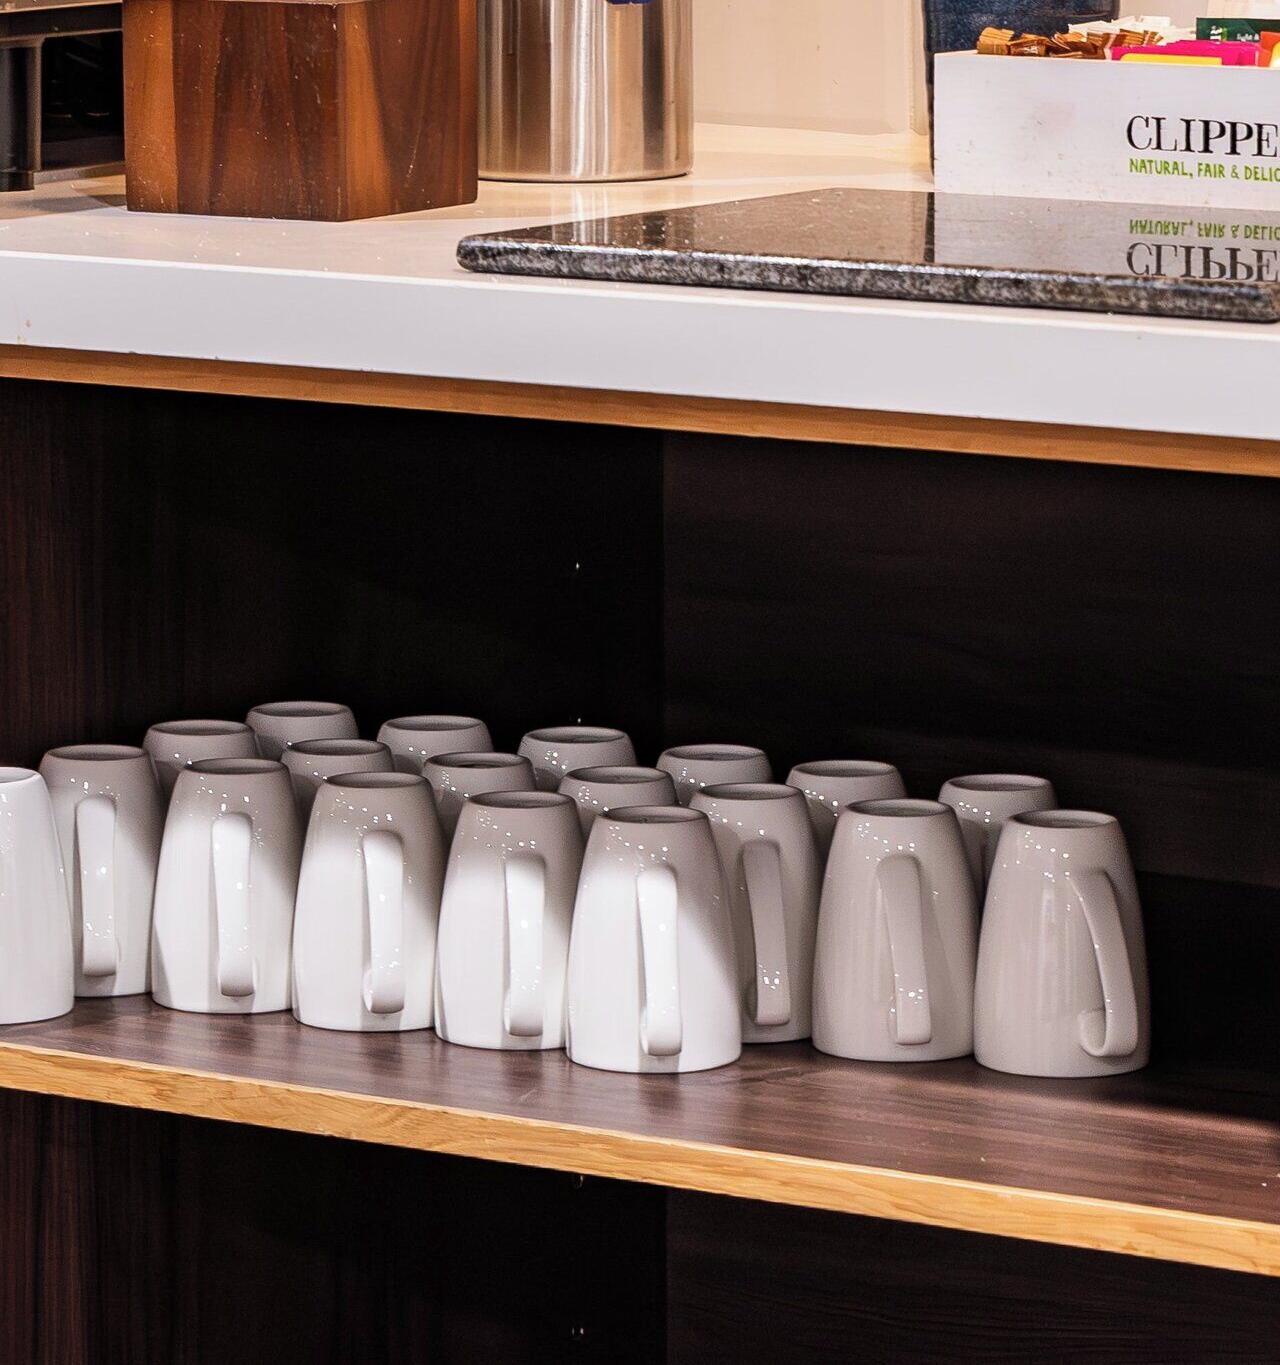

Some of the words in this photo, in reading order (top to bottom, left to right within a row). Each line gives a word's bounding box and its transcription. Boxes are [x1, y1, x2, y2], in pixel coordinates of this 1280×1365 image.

[1129, 158, 1193, 179] NATURAL,
[1197, 162, 1225, 178] FAIR
[1230, 164, 1240, 179] &
